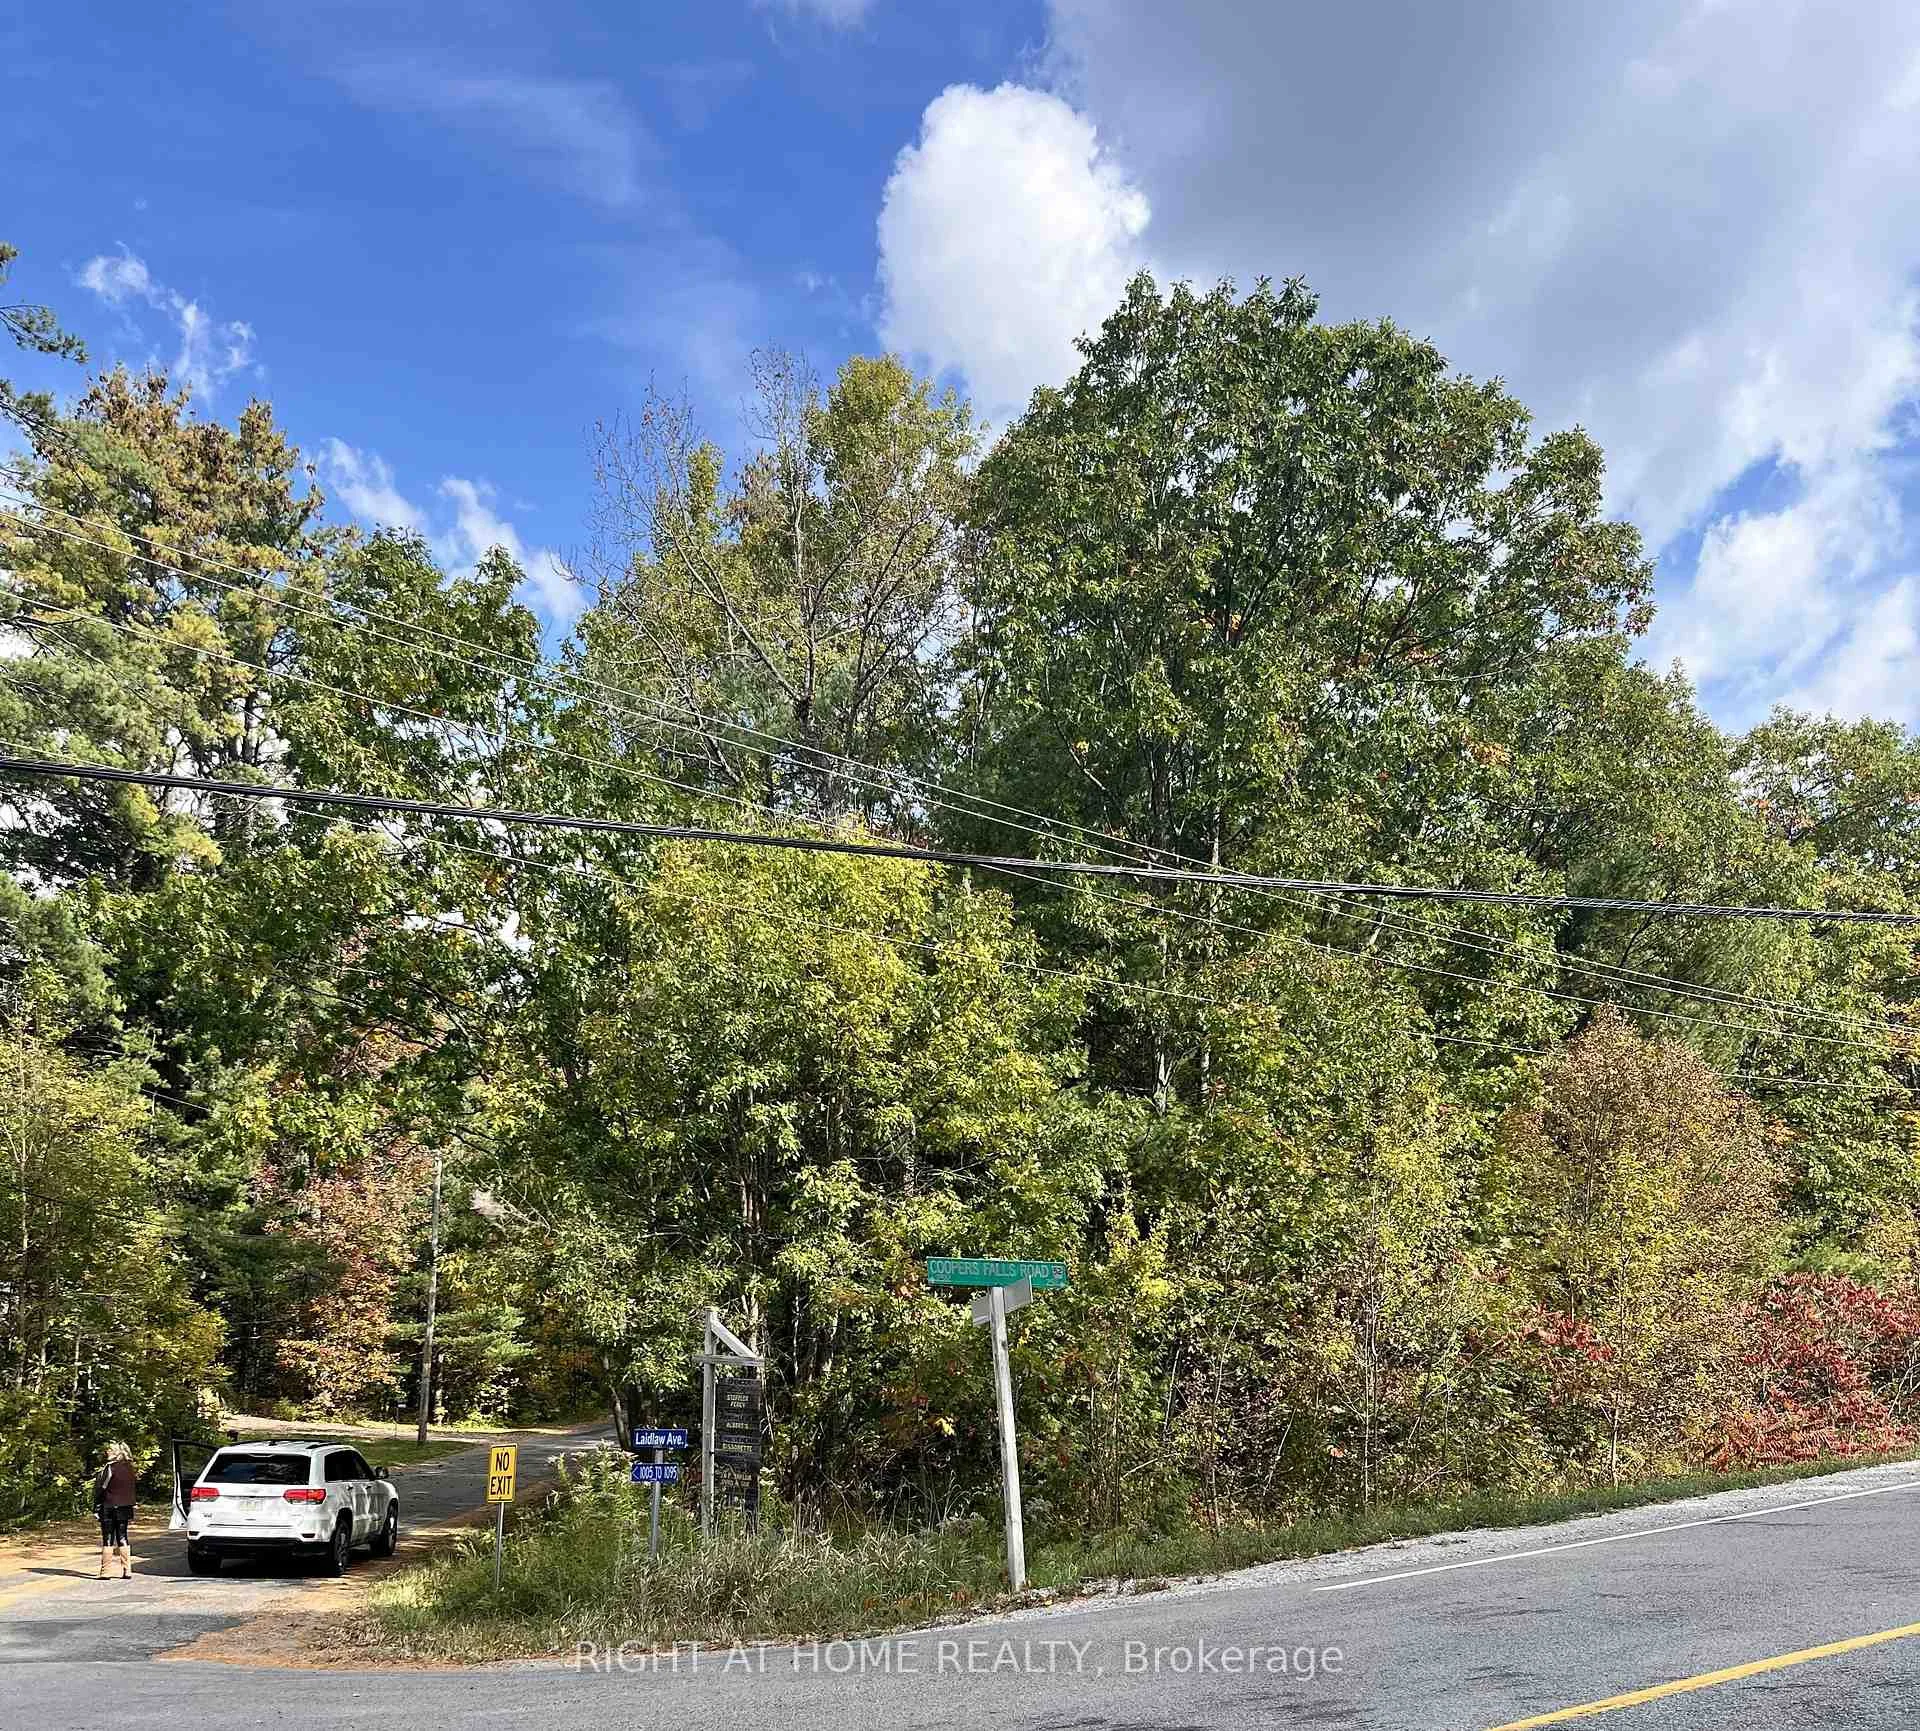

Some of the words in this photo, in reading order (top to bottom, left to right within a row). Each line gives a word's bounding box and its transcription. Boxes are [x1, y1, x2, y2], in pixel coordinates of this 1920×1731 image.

[930, 1260, 979, 1275] COOPERS
[983, 1262, 1016, 1277] FALLS
[1020, 1264, 1049, 1278] ROAD
[635, 1432, 665, 1445] Laidlaw
[666, 1432, 684, 1445] Ave.
[495, 1451, 510, 1472] NO
[655, 1465, 662, 1479] TO
[490, 1475, 512, 1495] EXIT
